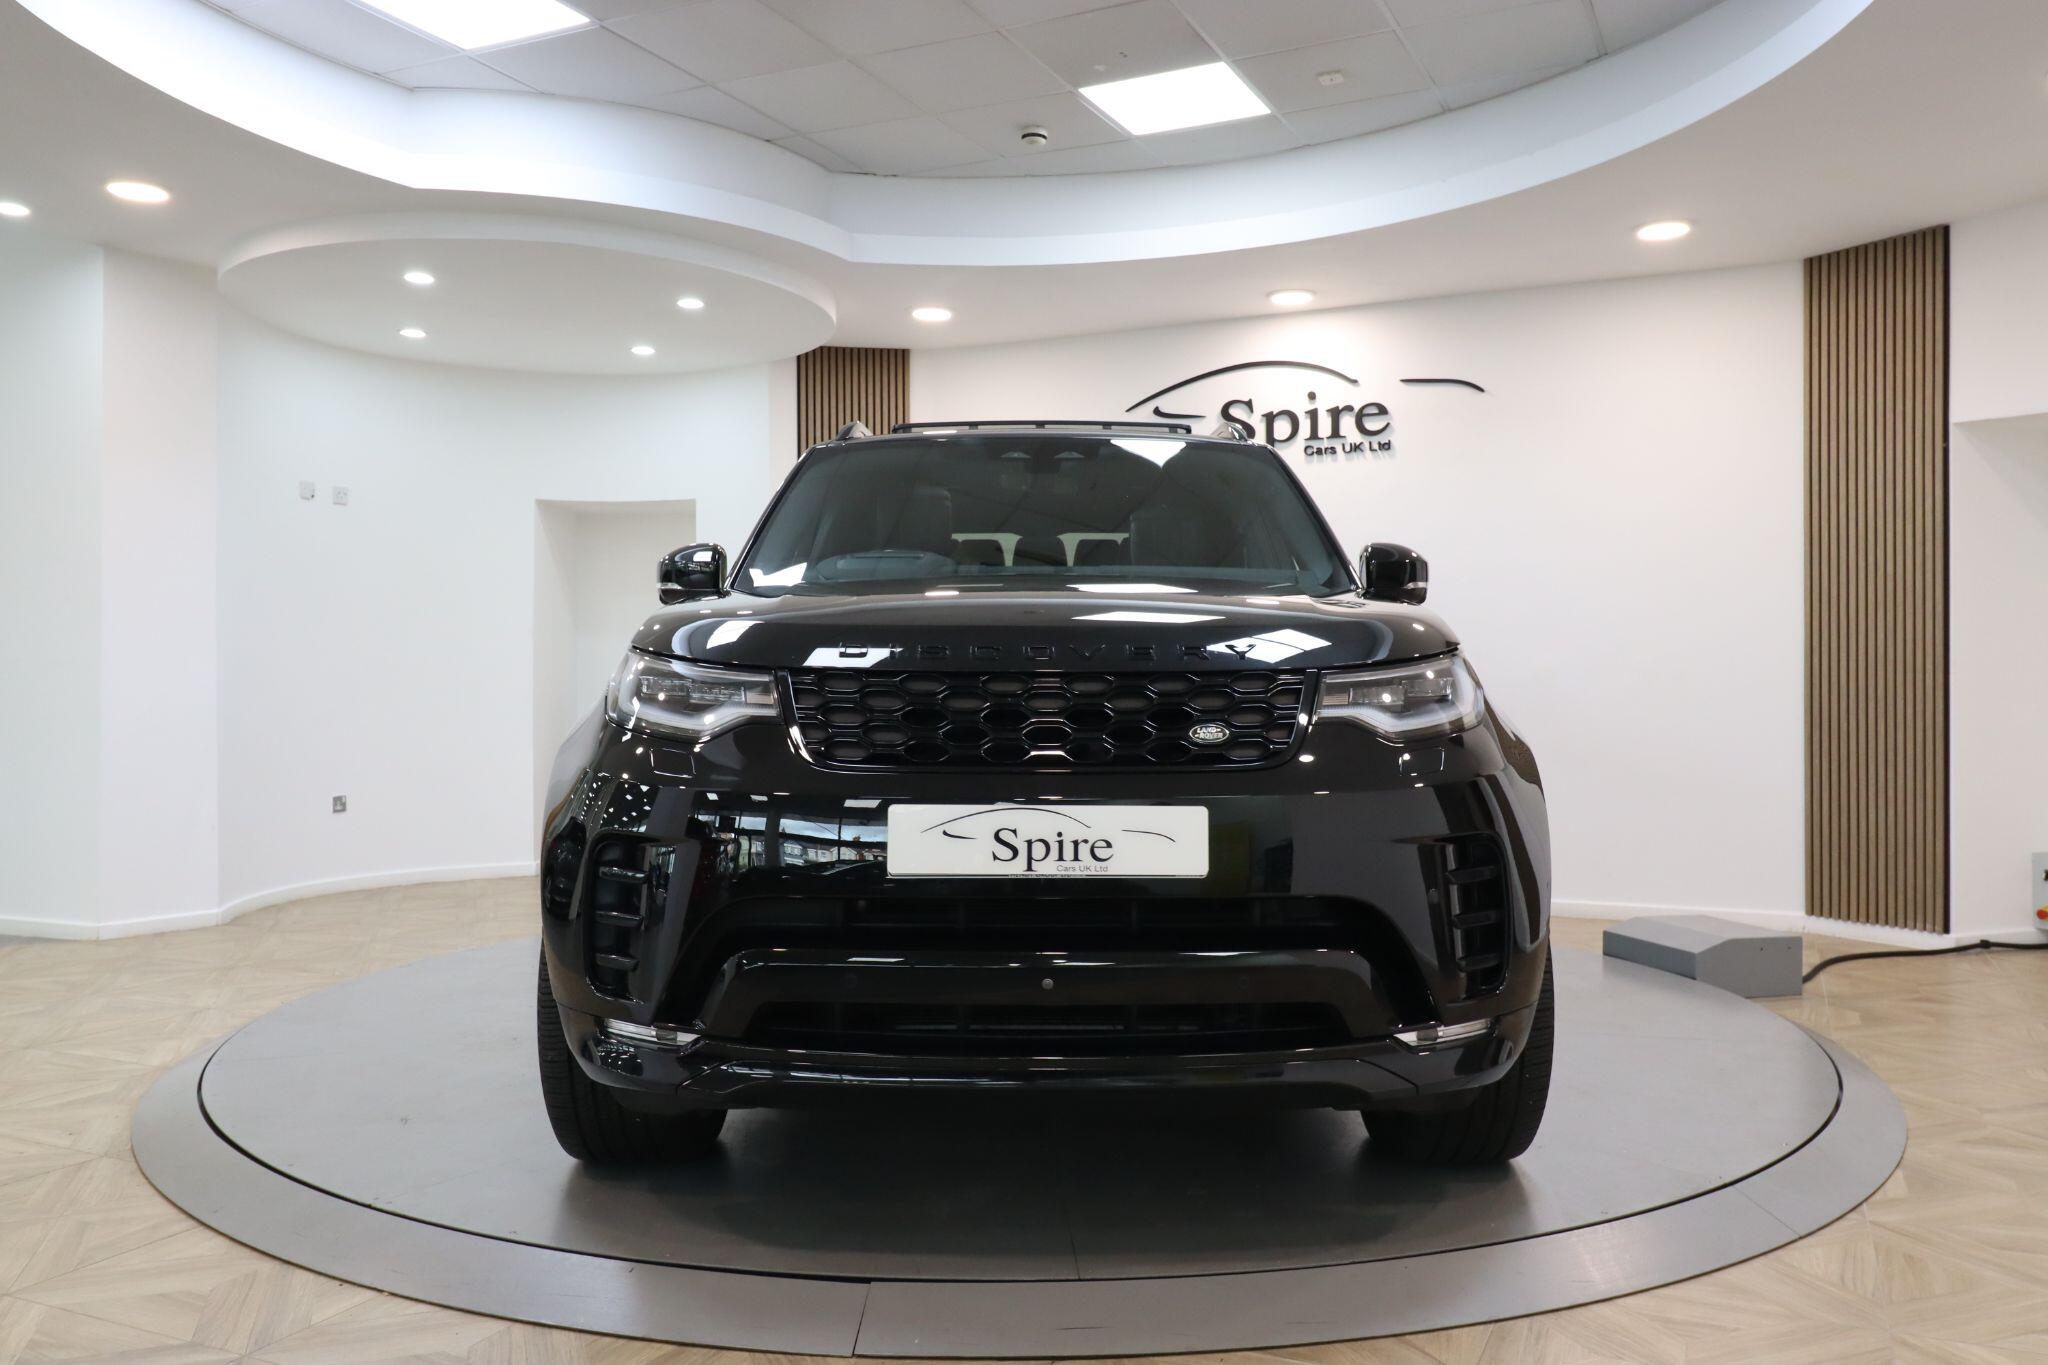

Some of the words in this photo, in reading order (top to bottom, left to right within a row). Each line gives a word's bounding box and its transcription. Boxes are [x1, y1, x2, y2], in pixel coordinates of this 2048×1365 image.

[1220, 391, 1391, 448] Spire
[1304, 445, 1337, 457] Cars
[1342, 442, 1364, 454] UK
[1369, 440, 1391, 452] Ltd
[838, 641, 1256, 661] DISCOVERY
[992, 827, 1114, 872] Spire
[1056, 864, 1077, 873] Cars
[1078, 864, 1092, 873] UK
[1094, 864, 1108, 873] Ltd
